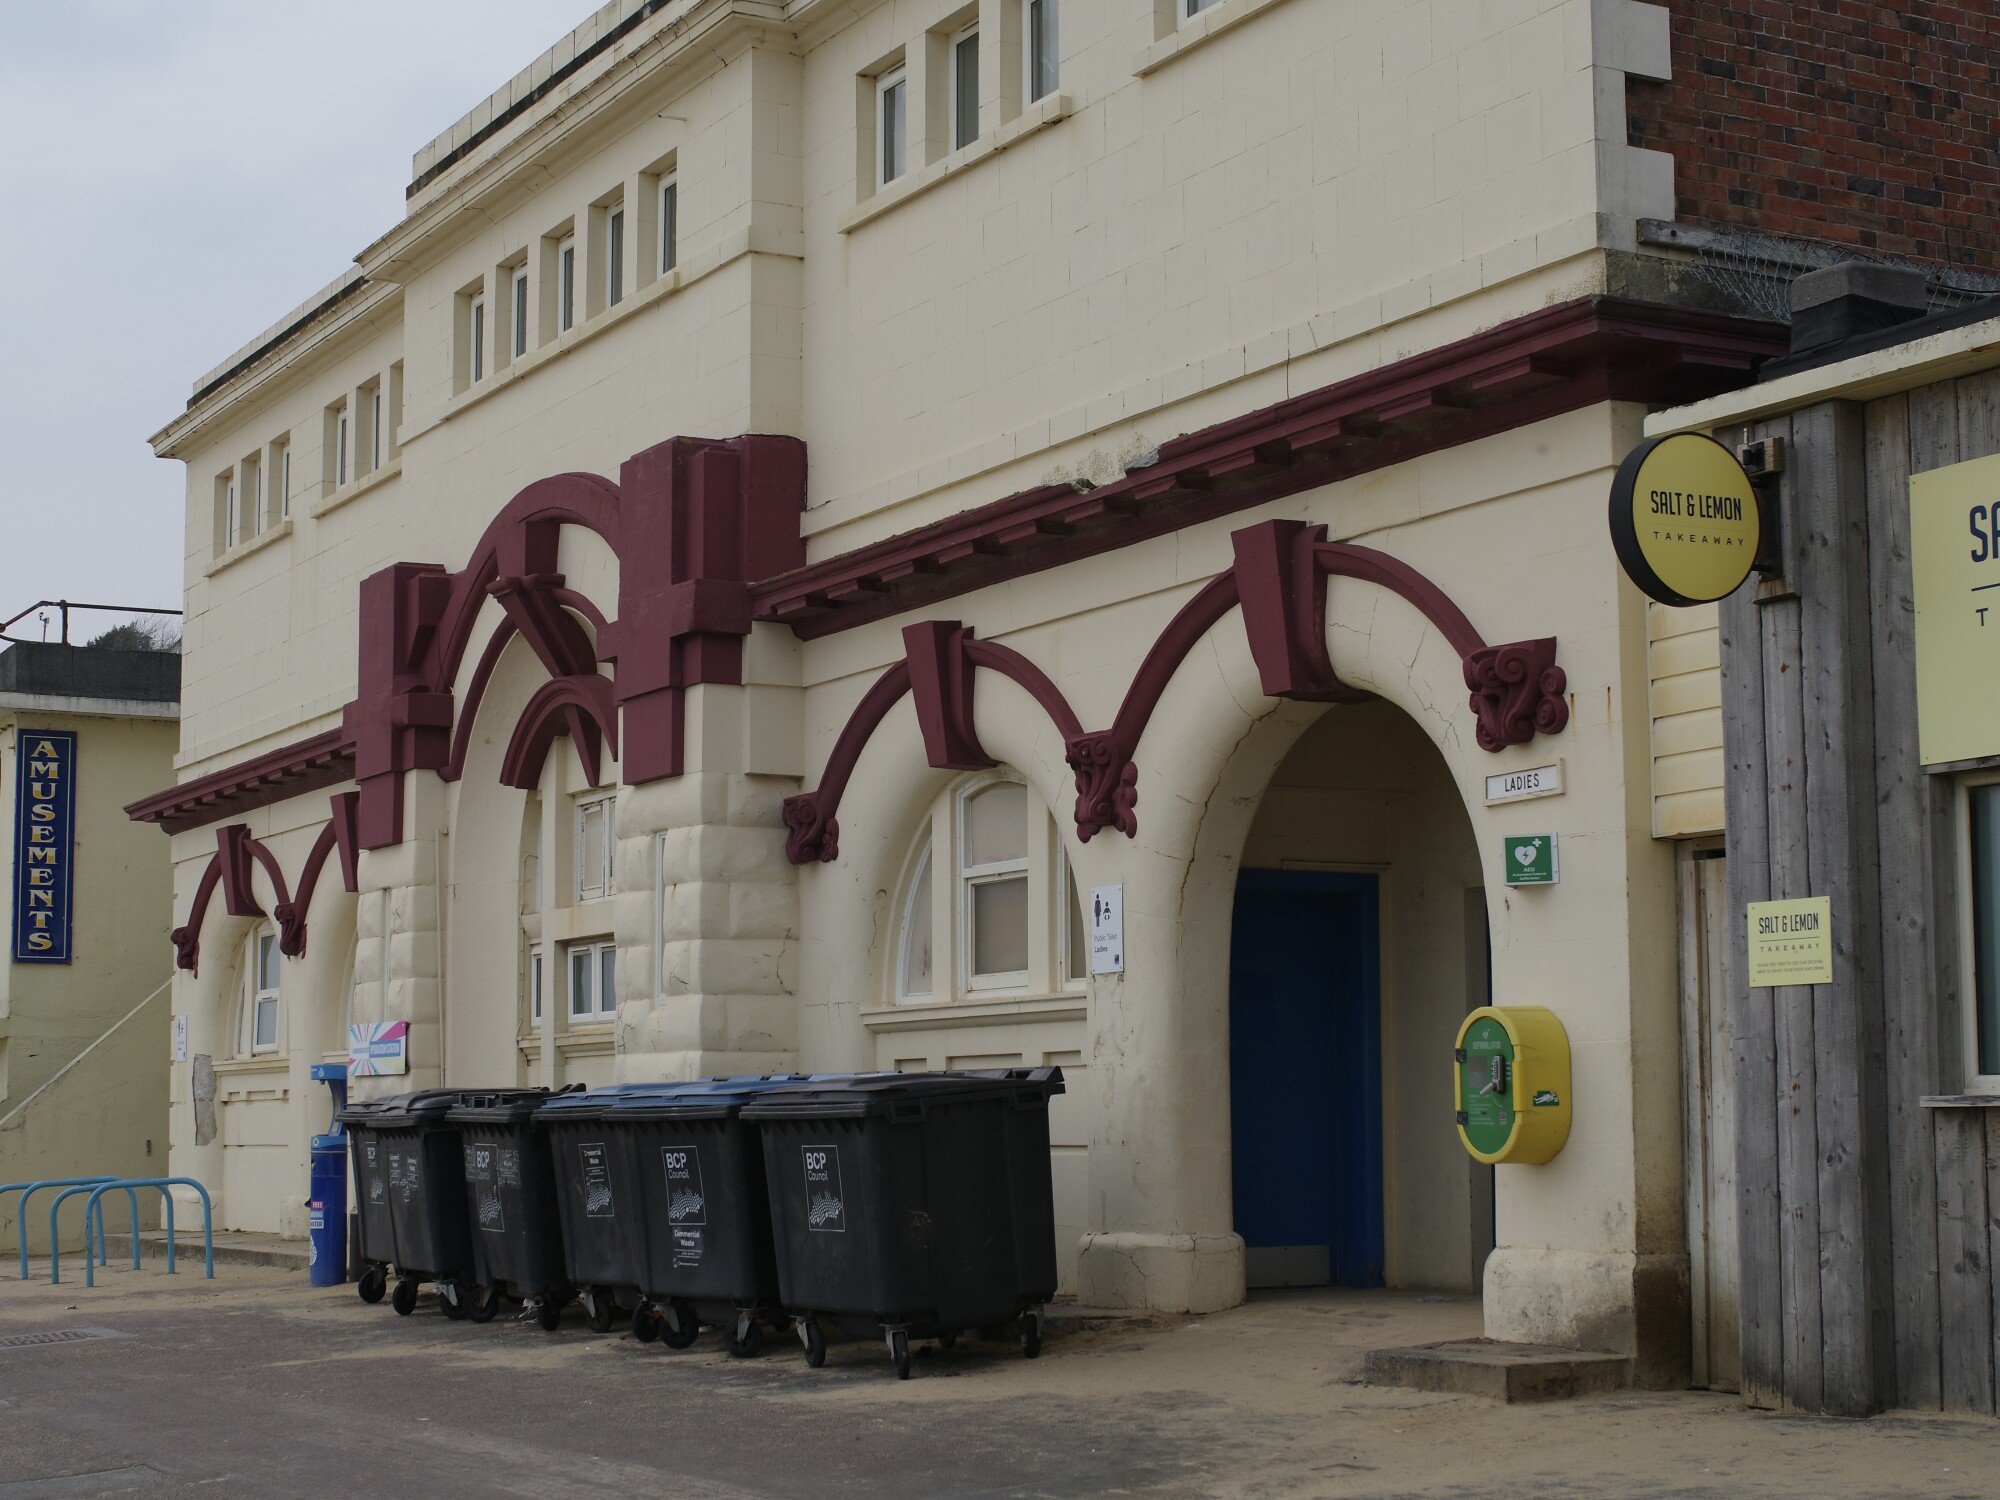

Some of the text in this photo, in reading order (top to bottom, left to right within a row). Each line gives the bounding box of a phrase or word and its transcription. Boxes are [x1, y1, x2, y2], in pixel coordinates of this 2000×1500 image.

[1651, 490, 1742, 521] SALT & LEMON
[1653, 531, 1744, 546] TAKEAWAY
[1504, 773, 1540, 792] LADIES
[27, 740, 60, 951] AMUSEMENTS
[1759, 913, 1819, 934] SALT & LEMON
[1094, 933, 1118, 942] Public Toilet
[1094, 946, 1108, 954] Ladies
[1760, 943, 1820, 953] TAKEAWAY
[476, 1150, 490, 1168] BCP
[665, 1152, 687, 1169] BCP
[805, 1152, 827, 1170] BCP
[668, 1169, 689, 1179] Council
[807, 1170, 829, 1181] Council
[312, 1201, 324, 1209] FREE
[674, 1229, 700, 1238] Commercial
[680, 1239, 695, 1247] Waste
